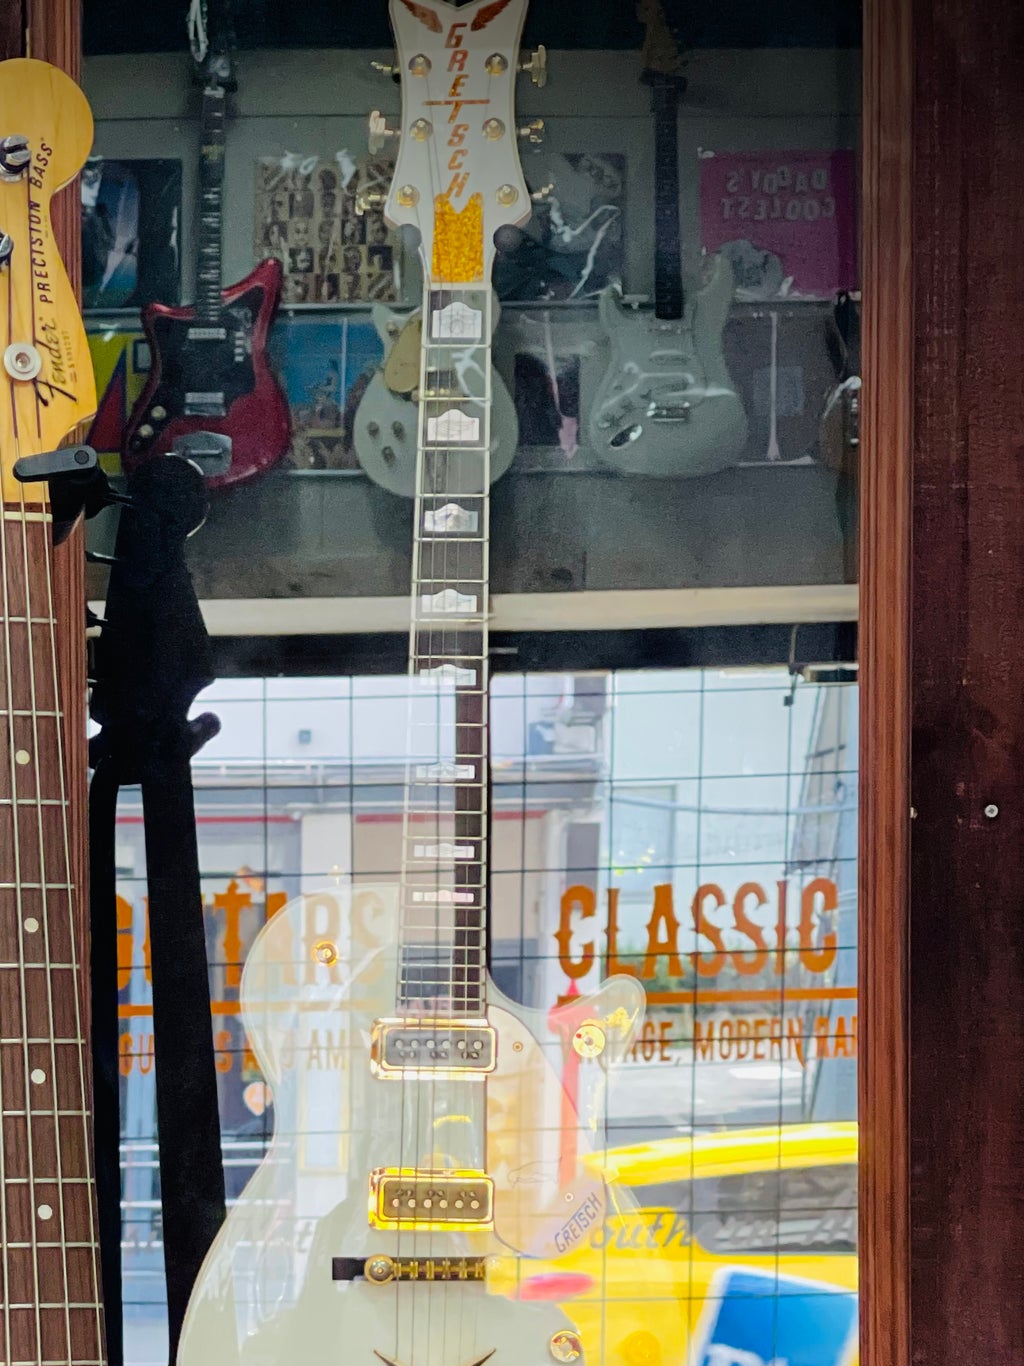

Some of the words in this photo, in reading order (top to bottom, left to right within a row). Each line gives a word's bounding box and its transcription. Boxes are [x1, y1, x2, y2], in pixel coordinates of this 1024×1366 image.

[422, 22, 490, 198] GRETSCH
[29, 142, 53, 189] BASS
[27, 199, 54, 304] PRECISION
[31, 318, 78, 407] Fender
[553, 877, 839, 979] CLASSIC
[692, 1015, 808, 1069] MODERN
[554, 1192, 602, 1253] GRETSCH
